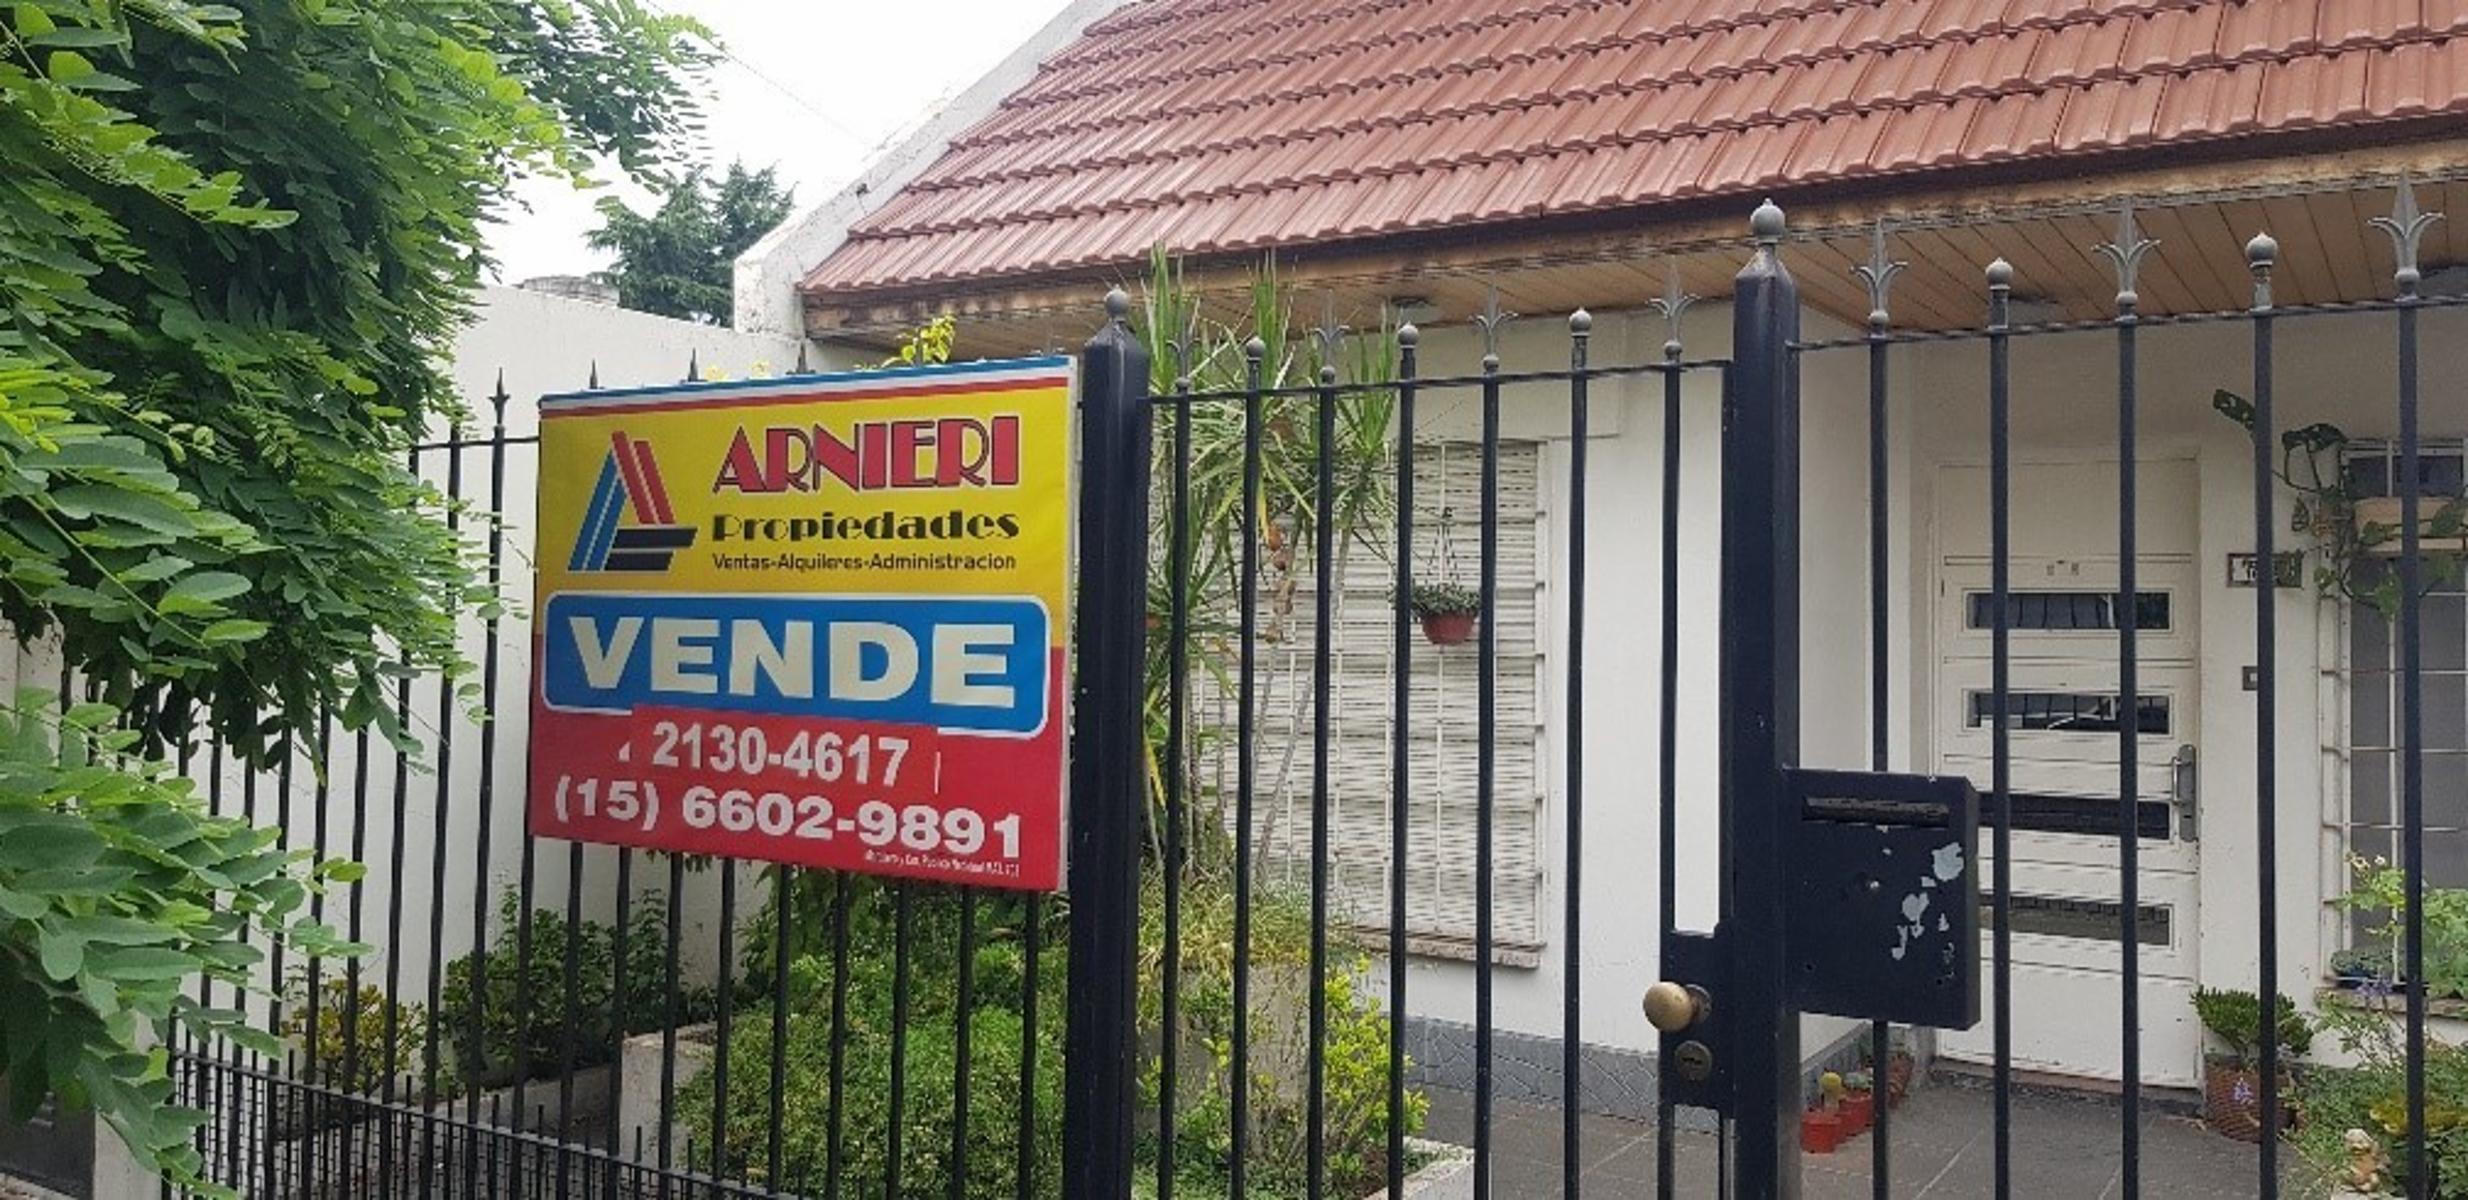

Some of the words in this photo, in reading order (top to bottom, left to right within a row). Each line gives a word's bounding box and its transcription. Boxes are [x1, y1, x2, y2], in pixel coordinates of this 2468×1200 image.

[712, 416, 1020, 494] ARNIERI
[712, 511, 1019, 541] Propiedades
[569, 616, 1016, 709] VENDE
[652, 721, 910, 788] 2130-4617
[555, 775, 660, 832] (15)
[682, 787, 1021, 858] 6602-9891
